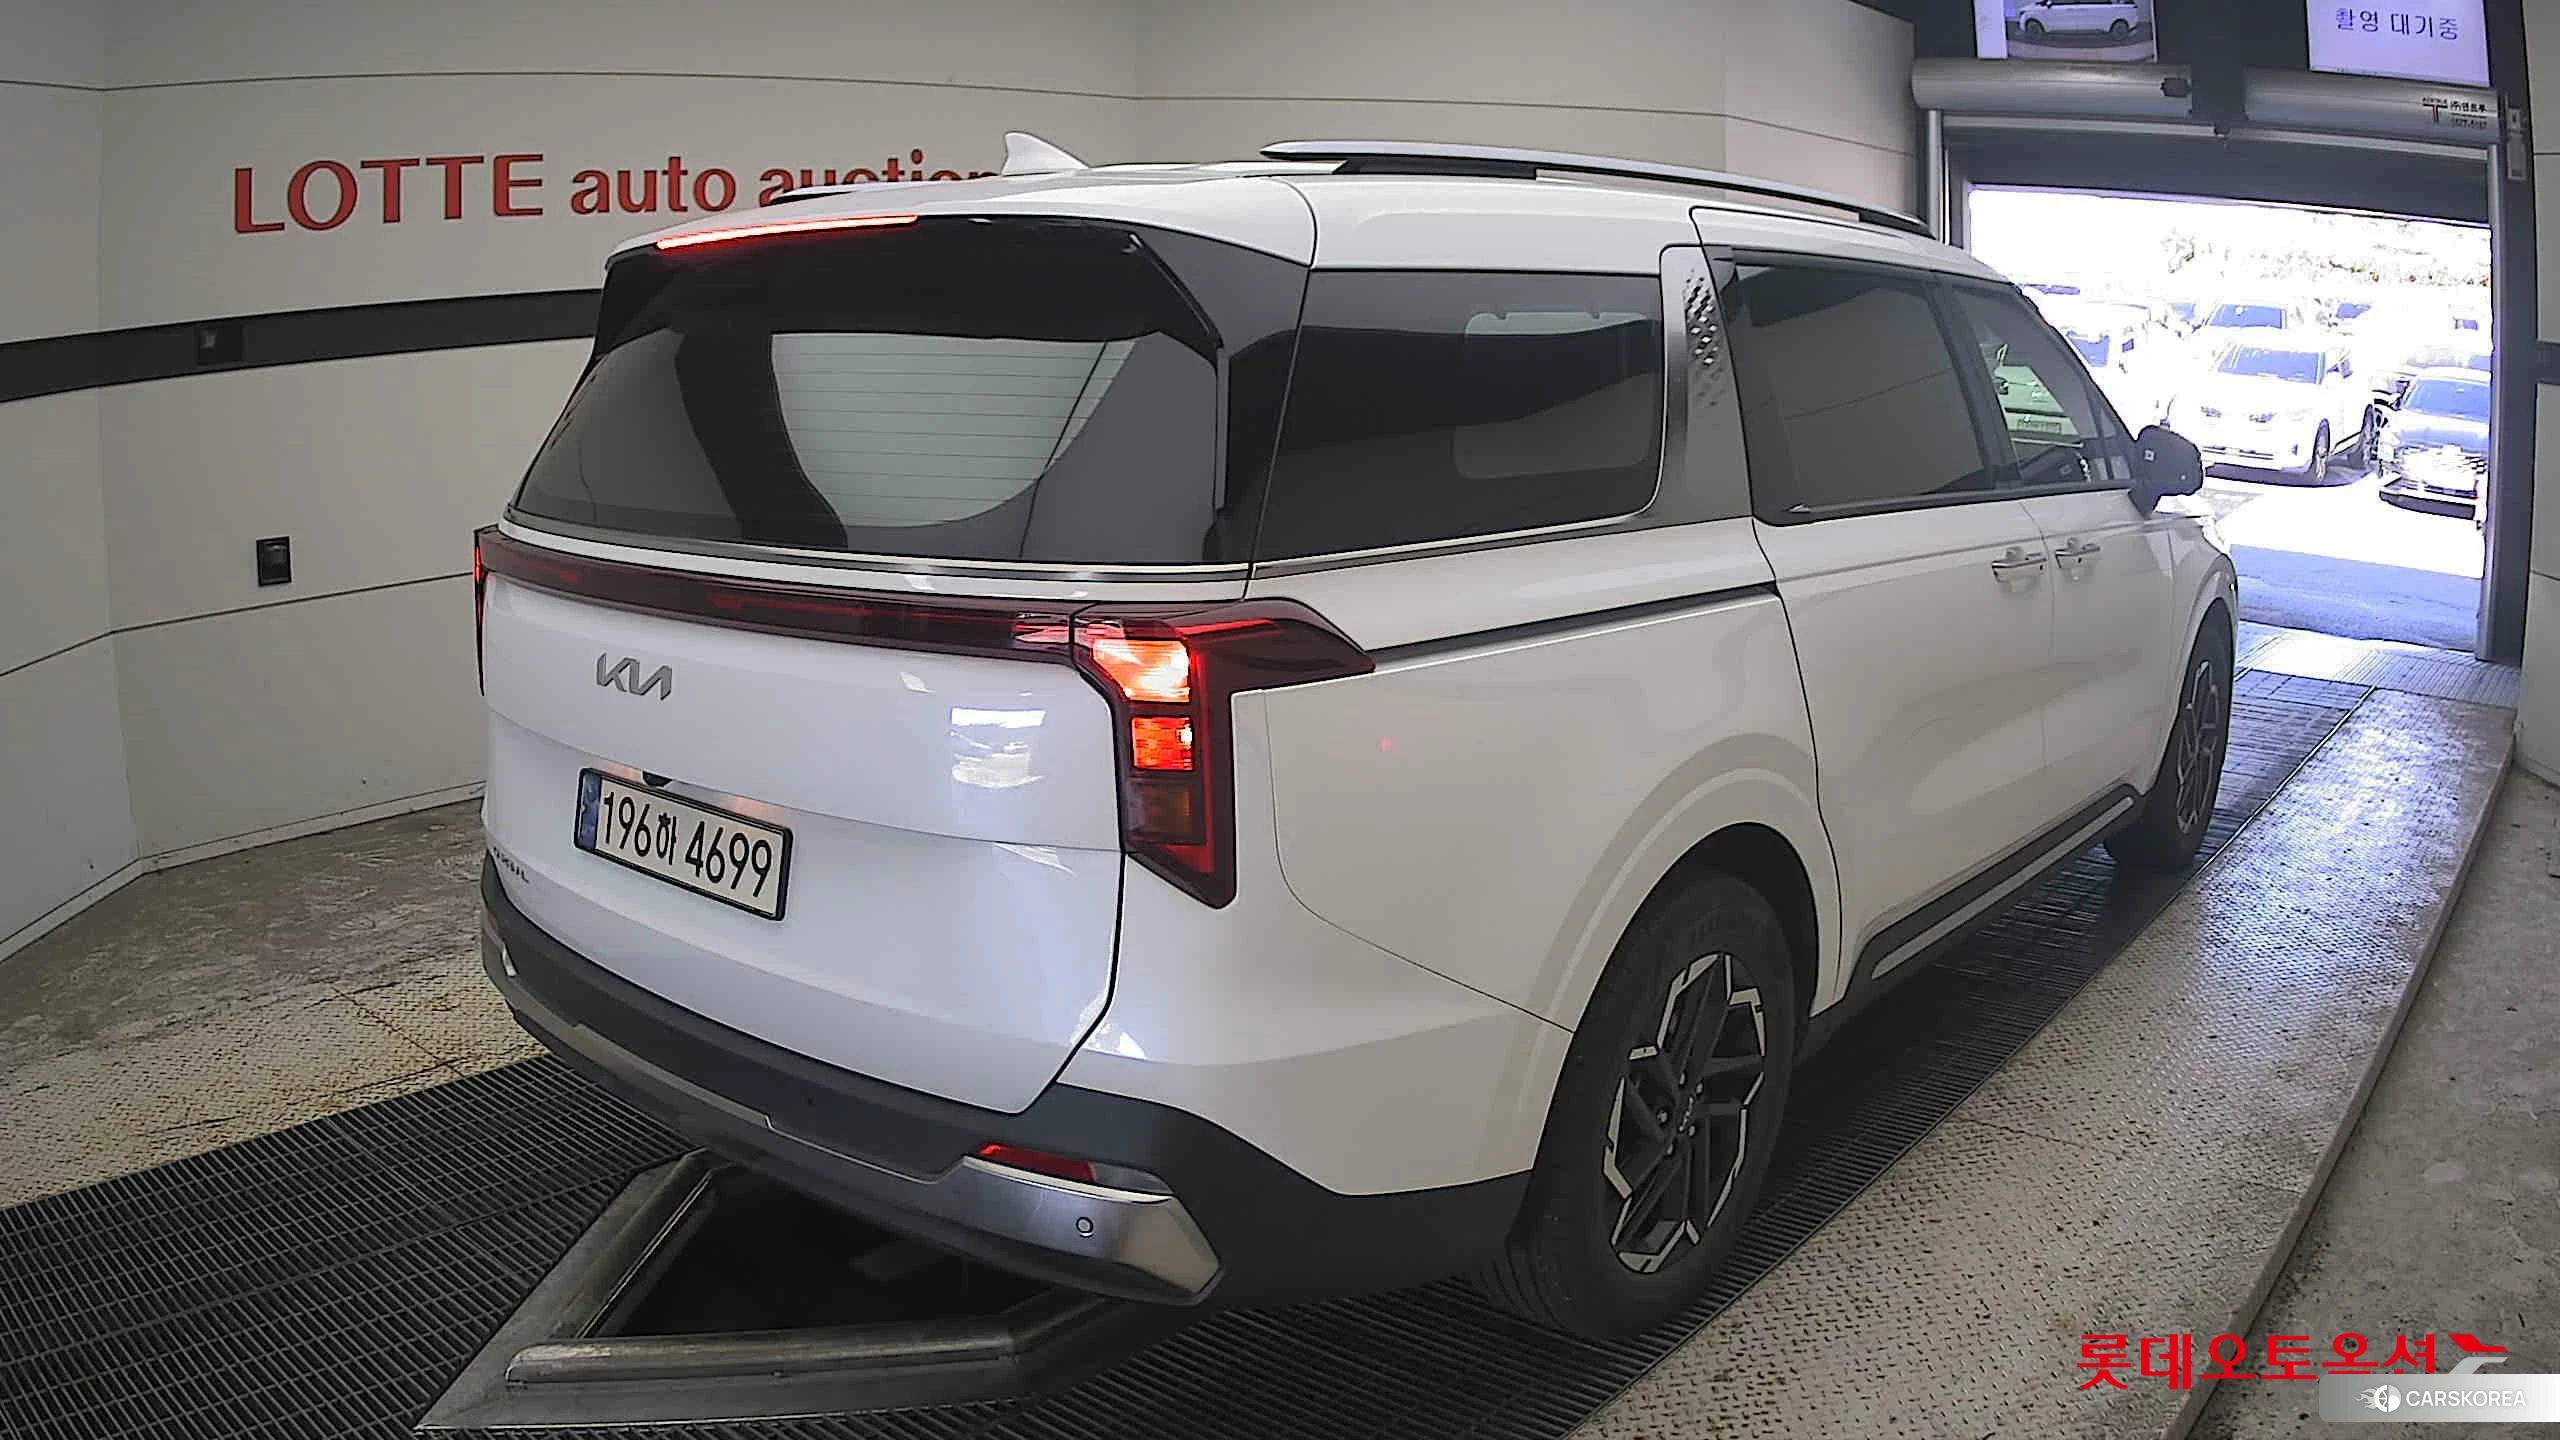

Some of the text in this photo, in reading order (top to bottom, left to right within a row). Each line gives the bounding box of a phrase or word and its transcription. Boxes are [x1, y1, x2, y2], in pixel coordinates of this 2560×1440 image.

[234, 148, 999, 233] LOTTE auto auti
[604, 791, 677, 865] 196하
[685, 820, 772, 898] 4699
